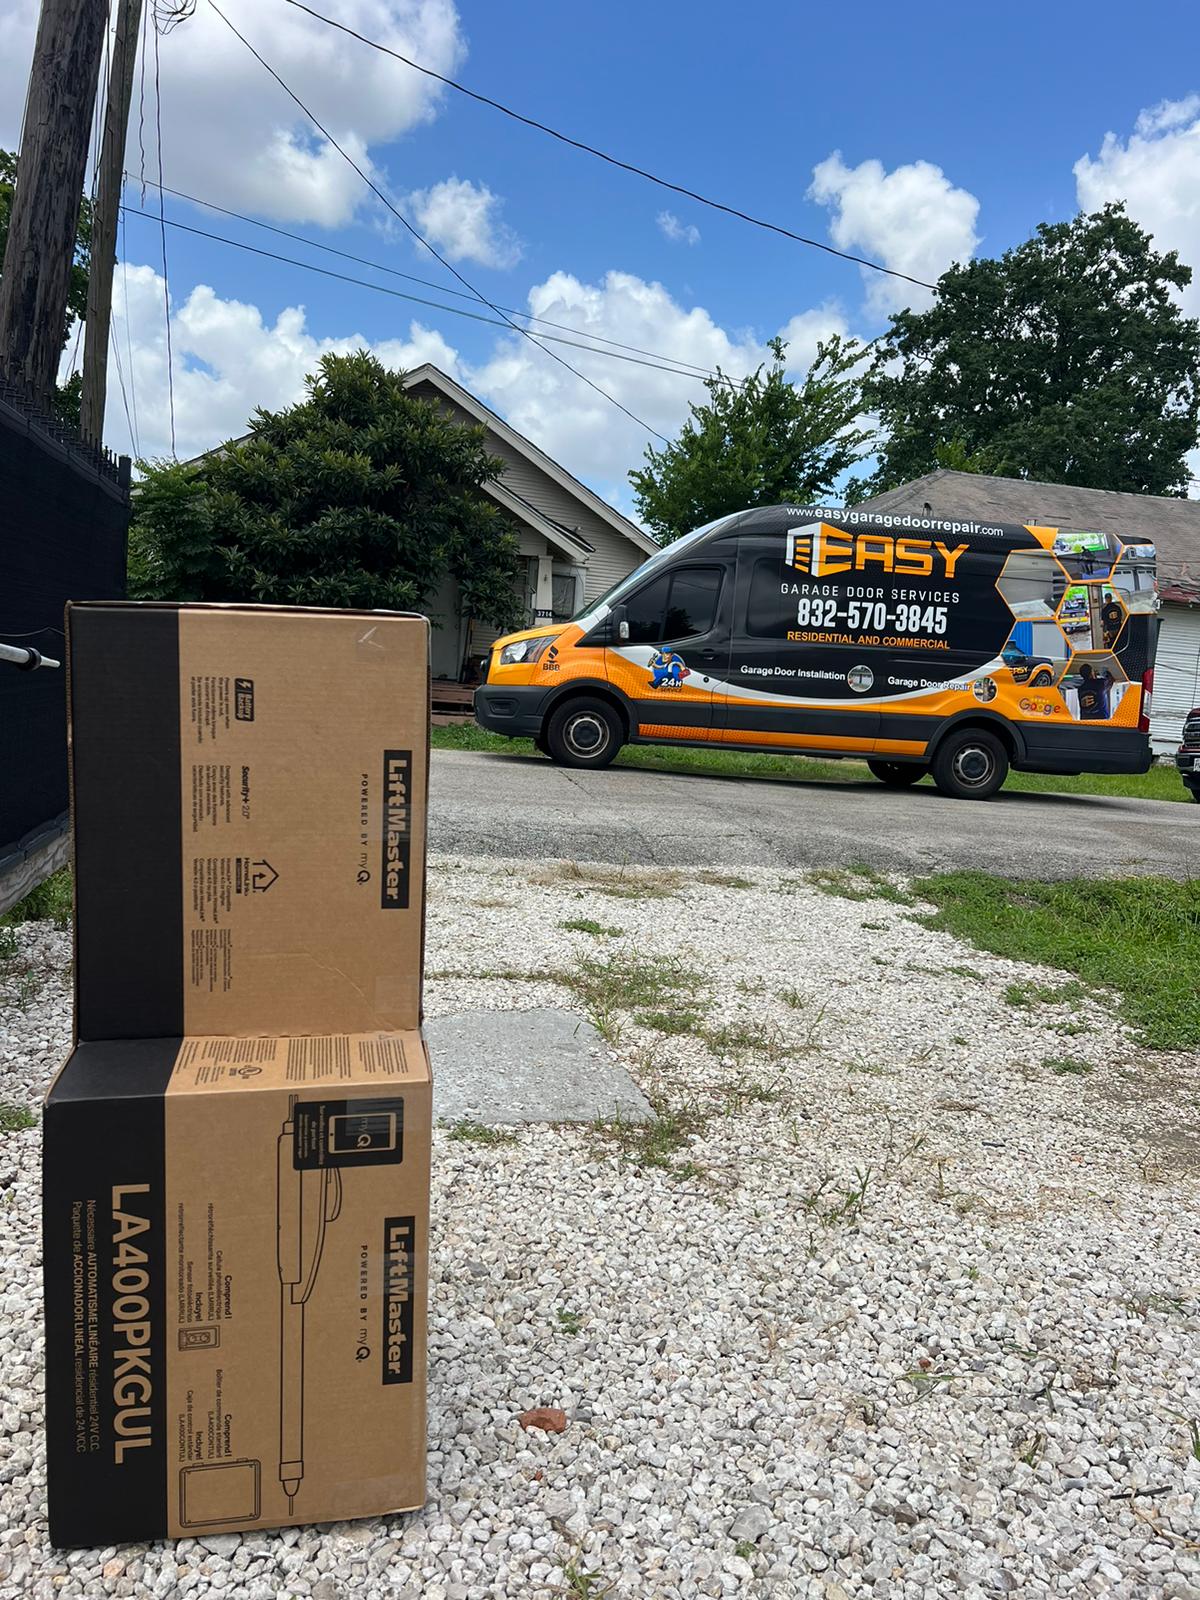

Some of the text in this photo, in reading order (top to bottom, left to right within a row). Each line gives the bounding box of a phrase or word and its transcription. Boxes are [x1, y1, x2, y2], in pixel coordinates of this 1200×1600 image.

[786, 507, 1004, 537] www.easygaragedoorrepair.com
[816, 521, 970, 578] EASY
[780, 583, 960, 604] GARAGE DOOR SERVICES
[797, 598, 948, 634] 832-570-3845
[787, 631, 951, 649] RESIDENTIAL AND COMMERCIAL
[542, 662, 560, 671] BBB
[741, 665, 846, 681] Garage Door Installation
[887, 676, 970, 692] Garage Door Repair
[1019, 698, 1061, 715] Google
[360, 774, 368, 826] POWERED
[360, 833, 368, 846] BY
[386, 759, 407, 900] LiftMaster
[71, 1200, 83, 1239] Paquete
[87, 1200, 97, 1251] Nécessaire
[73, 1240, 82, 1252] de
[73, 1254, 83, 1320] ACCIONADOR
[87, 1252, 98, 1323] AUTOMATISME
[360, 1245, 368, 1300] POWERED
[360, 1308, 368, 1320] BY
[388, 1226, 409, 1374] LiftMaster
[74, 1322, 84, 1357] LINEAL
[112, 1183, 152, 1465] LA400PKGUL
[88, 1324, 100, 1368] LINÉAIRE
[75, 1358, 84, 1405] residencial
[89, 1369, 99, 1415] résidentiel
[75, 1406, 85, 1418] de
[75, 1420, 85, 1431] 24
[89, 1416, 99, 1434] 24V
